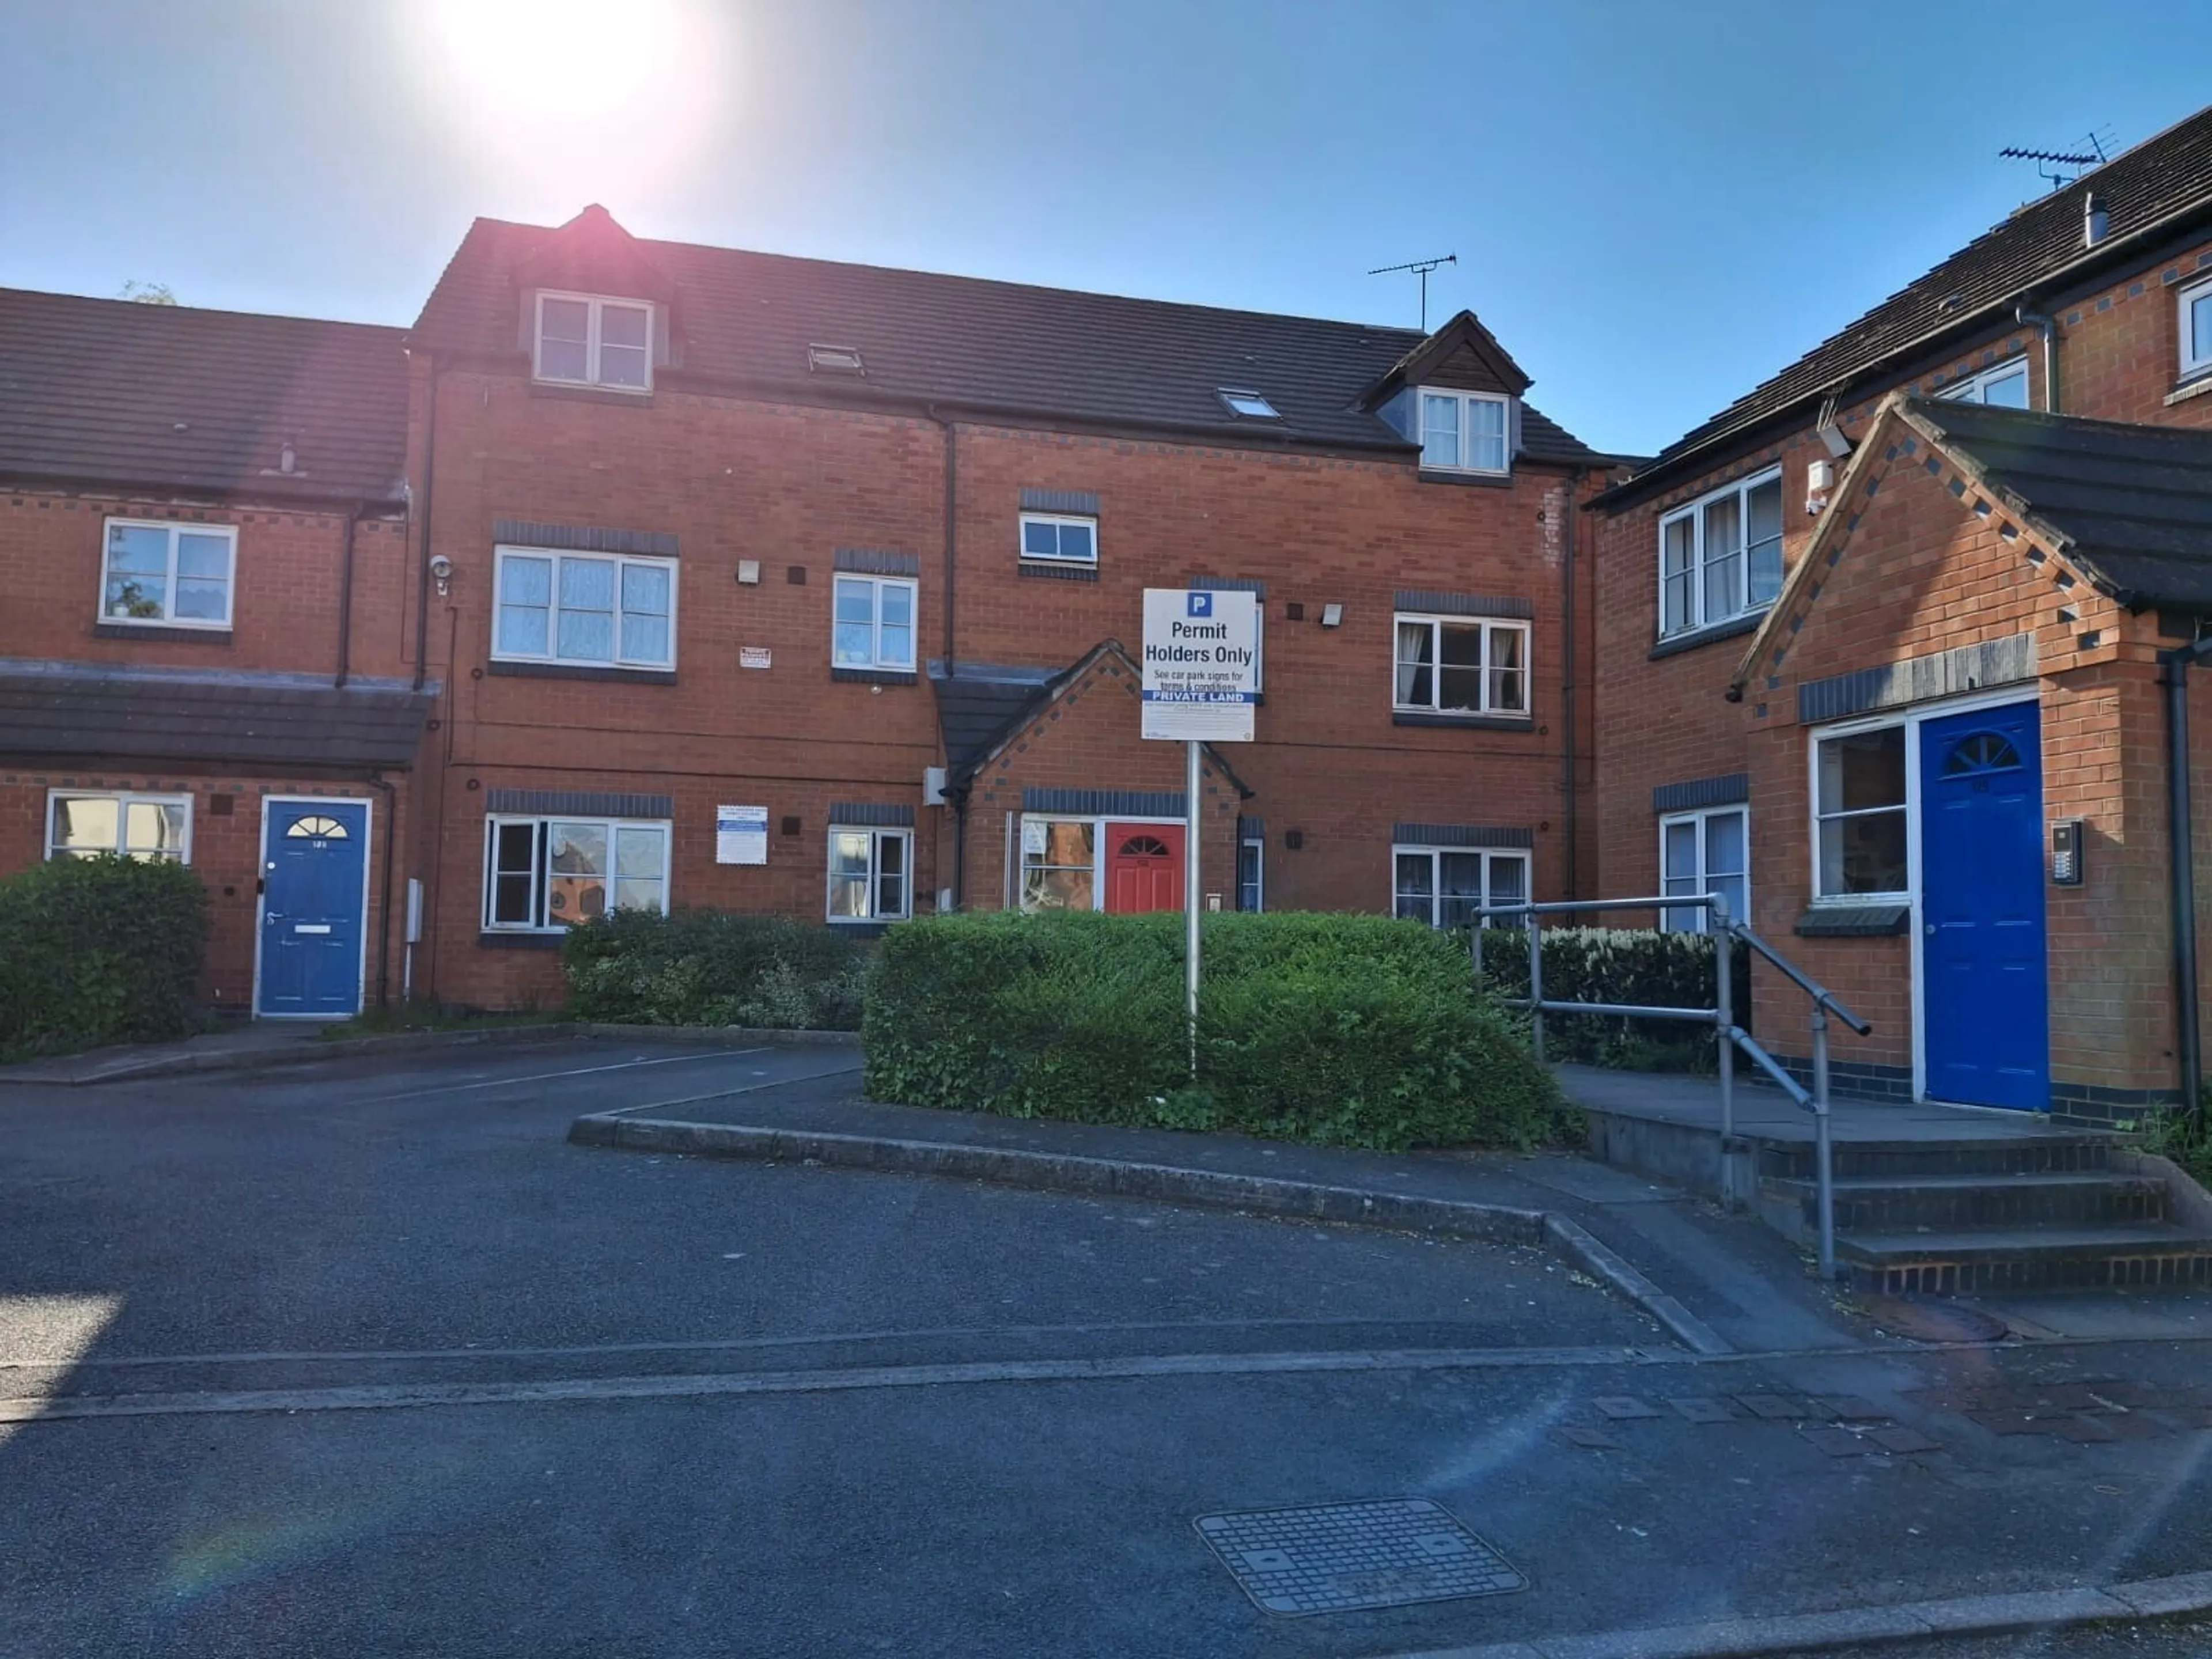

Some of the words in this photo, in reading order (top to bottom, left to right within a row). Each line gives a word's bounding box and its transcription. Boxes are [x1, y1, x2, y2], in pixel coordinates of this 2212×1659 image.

[1172, 622, 1227, 639] Permit
[1146, 645, 1210, 662] Holders
[1215, 646, 1252, 666] Only
[1154, 670, 1169, 679] See
[1187, 672, 1205, 681] park
[1208, 672, 1229, 681] signs
[1232, 672, 1243, 681] for
[1161, 682, 1183, 691] terms
[1194, 682, 1236, 691] conditions
[1153, 692, 1206, 701] PRIVATE
[1210, 693, 1244, 702] LAND
